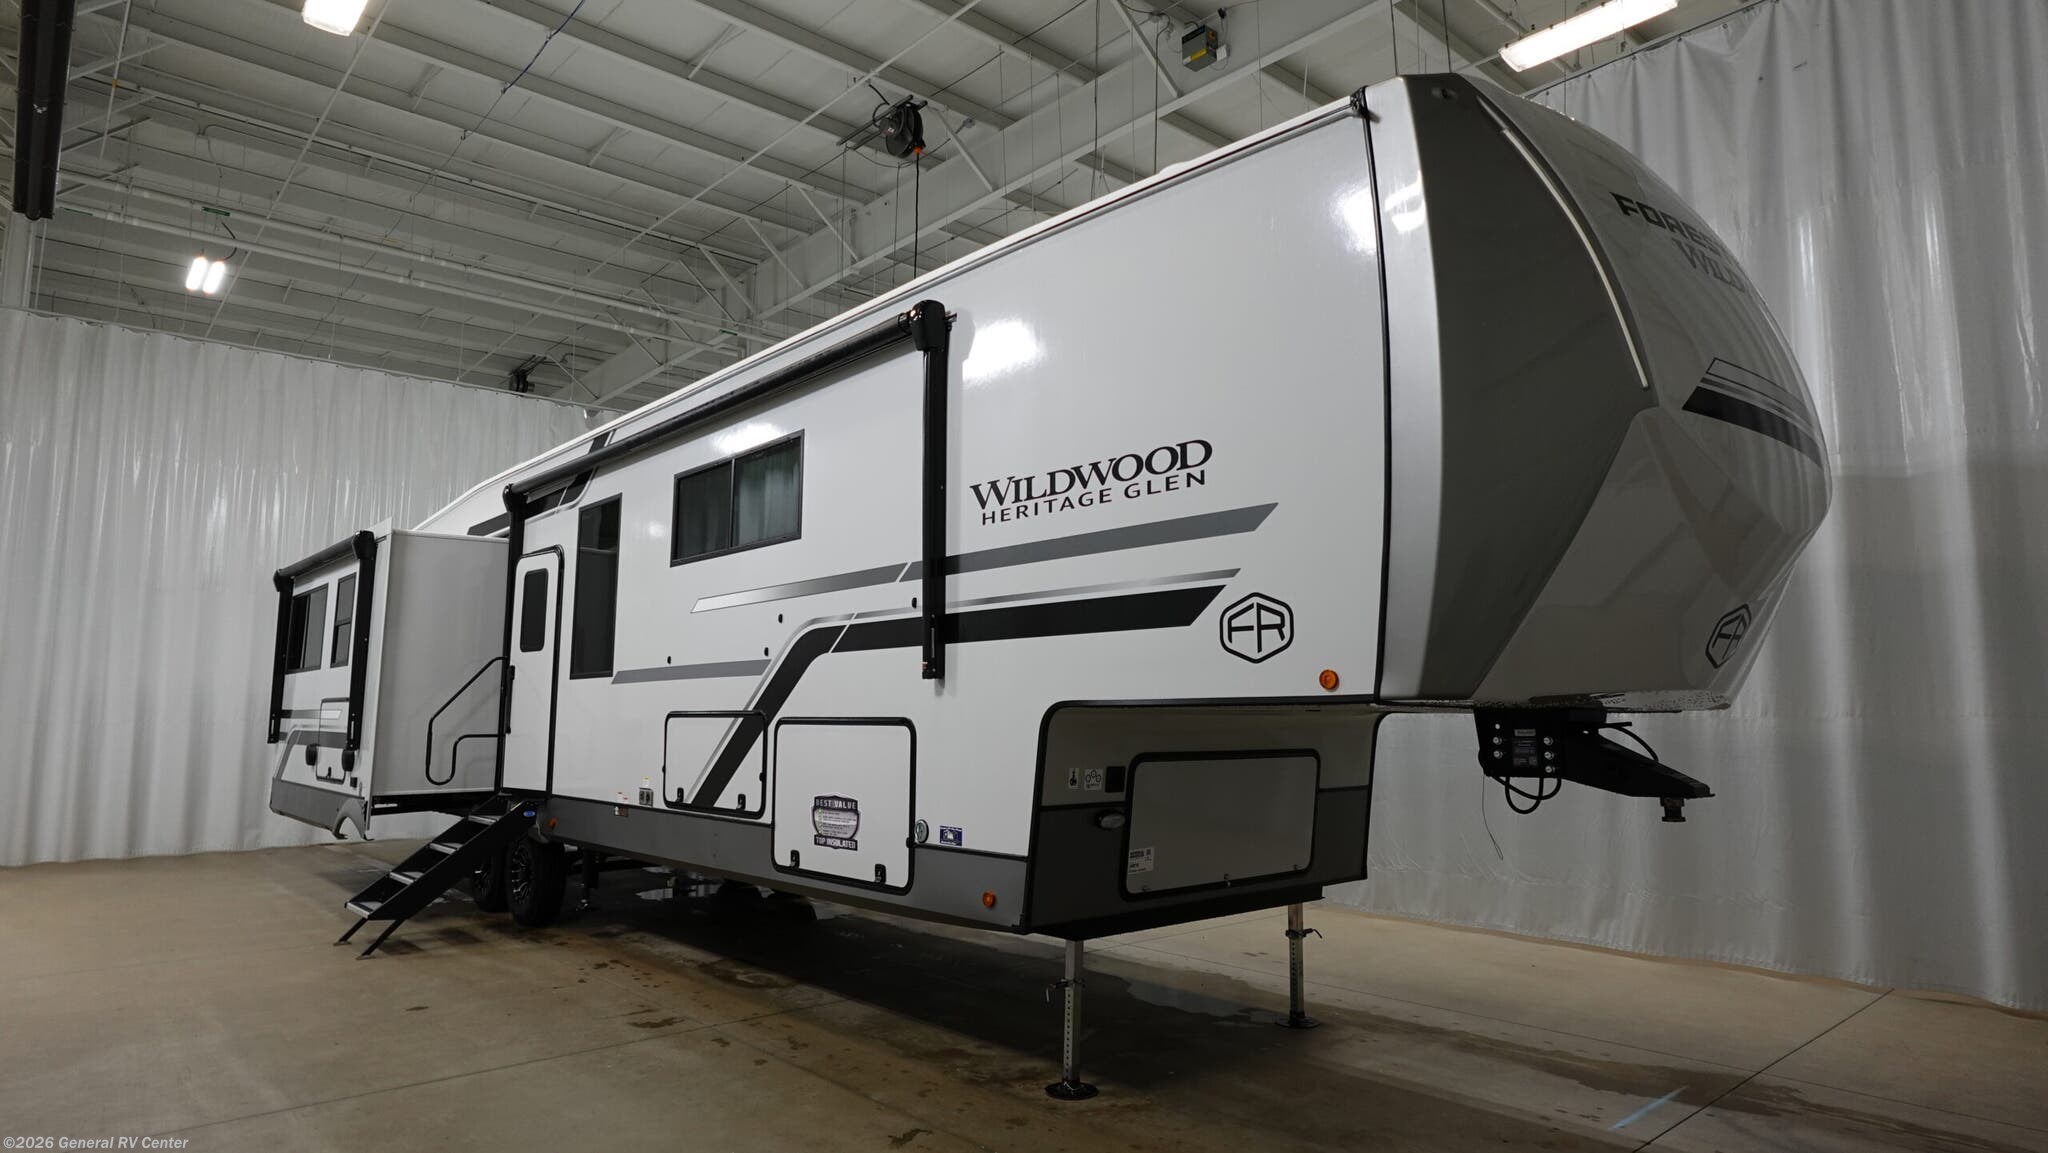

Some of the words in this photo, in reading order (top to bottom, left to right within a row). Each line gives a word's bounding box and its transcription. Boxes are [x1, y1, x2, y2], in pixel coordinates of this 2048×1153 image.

[1609, 191, 1724, 258] FORES
[970, 439, 1213, 510] WILDWOOD
[982, 488, 1113, 526] HERITAGE
[1124, 469, 1206, 500] GLEN
[816, 799, 832, 807] BEST
[834, 800, 856, 809] VALUE
[816, 837, 825, 845] TOP
